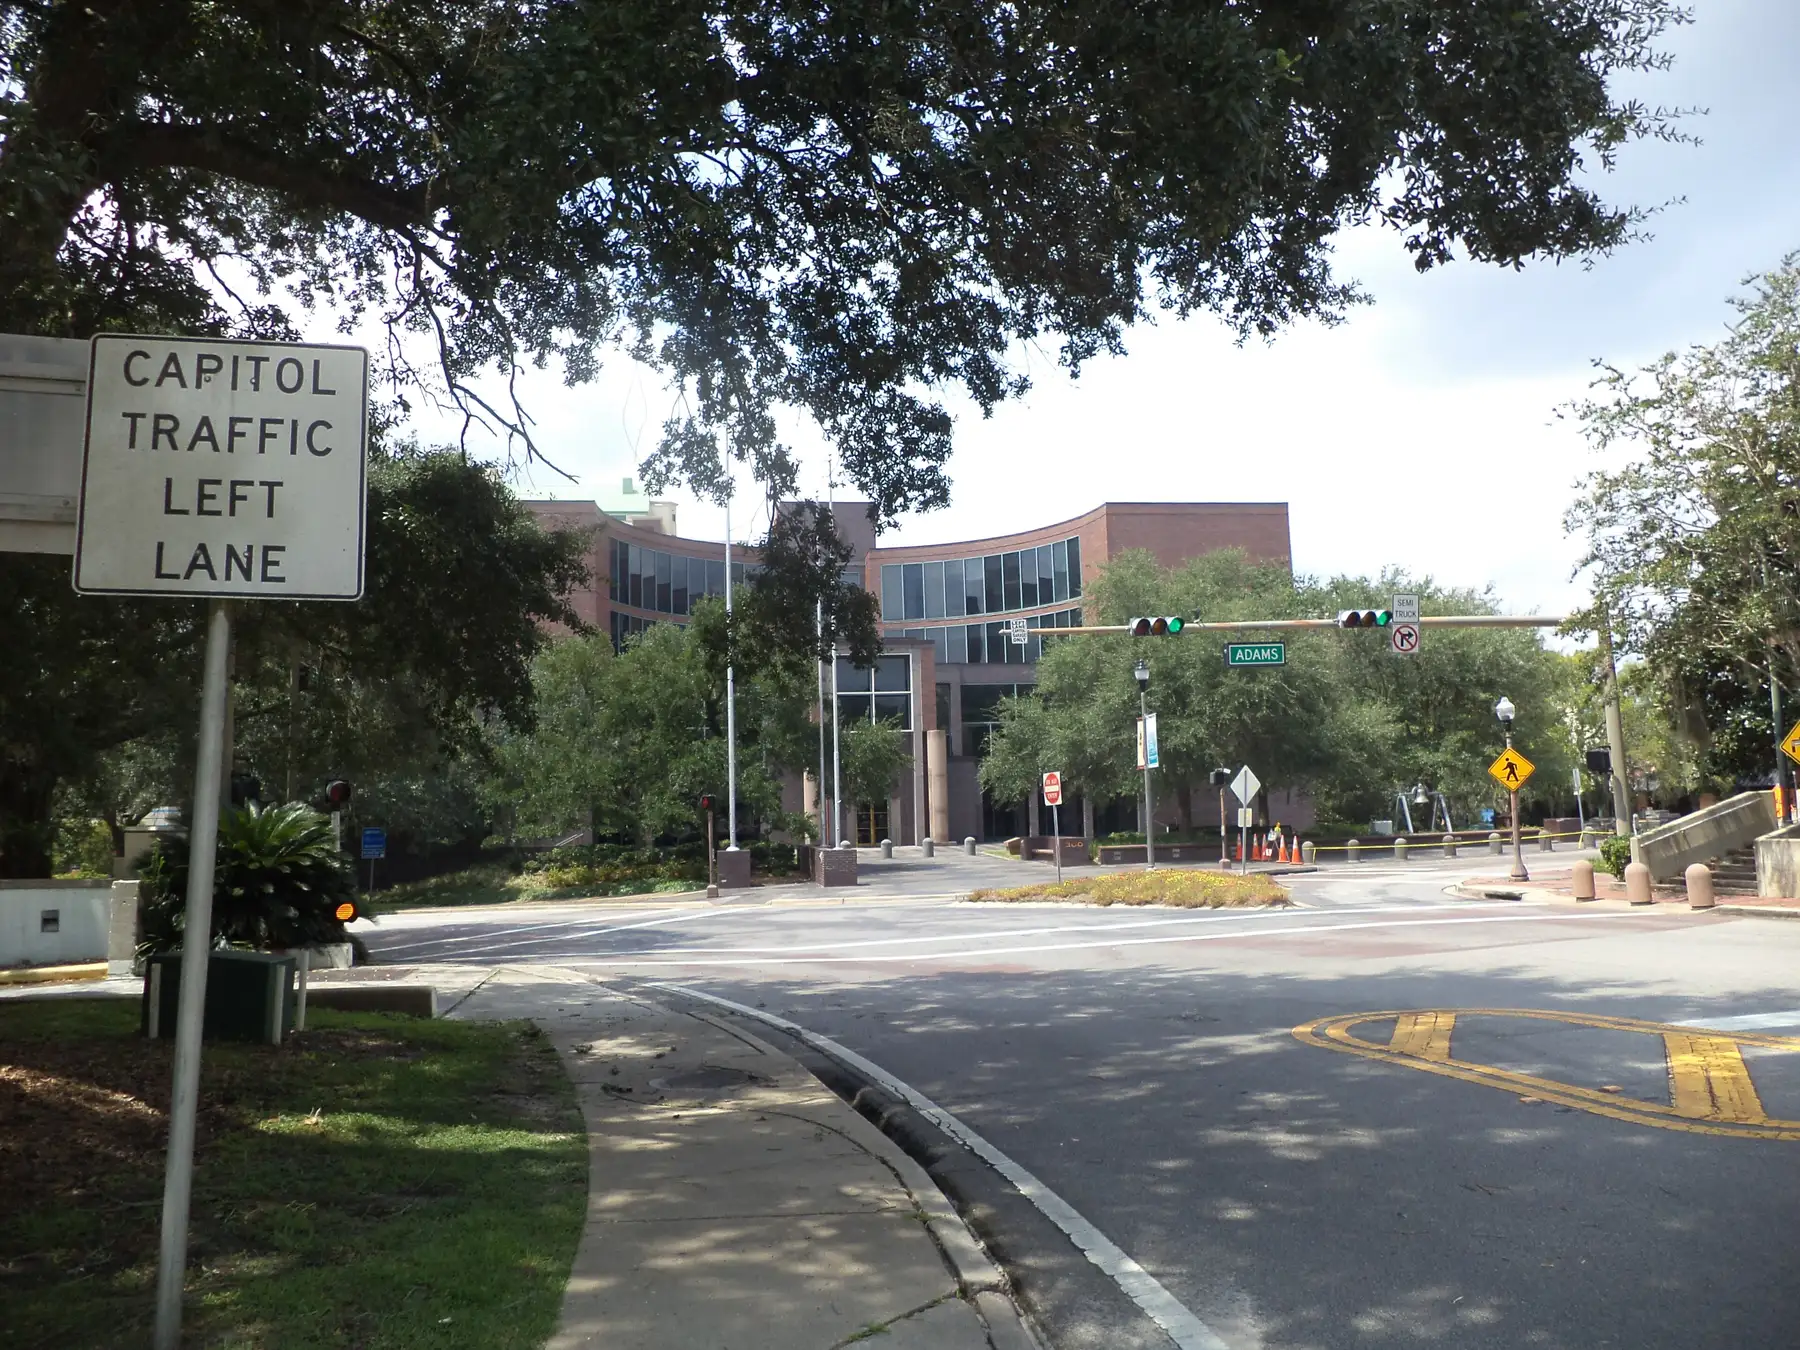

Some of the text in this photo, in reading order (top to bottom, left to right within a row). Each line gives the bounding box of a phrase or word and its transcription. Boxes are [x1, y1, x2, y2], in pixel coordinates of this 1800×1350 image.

[123, 350, 336, 396] CAPITOL
[121, 411, 333, 457] TRAFFIC
[164, 477, 284, 518] LEFT
[154, 541, 286, 583] LANE
[1395, 610, 1417, 618] TRUCK
[1235, 648, 1279, 661] ADAMS
